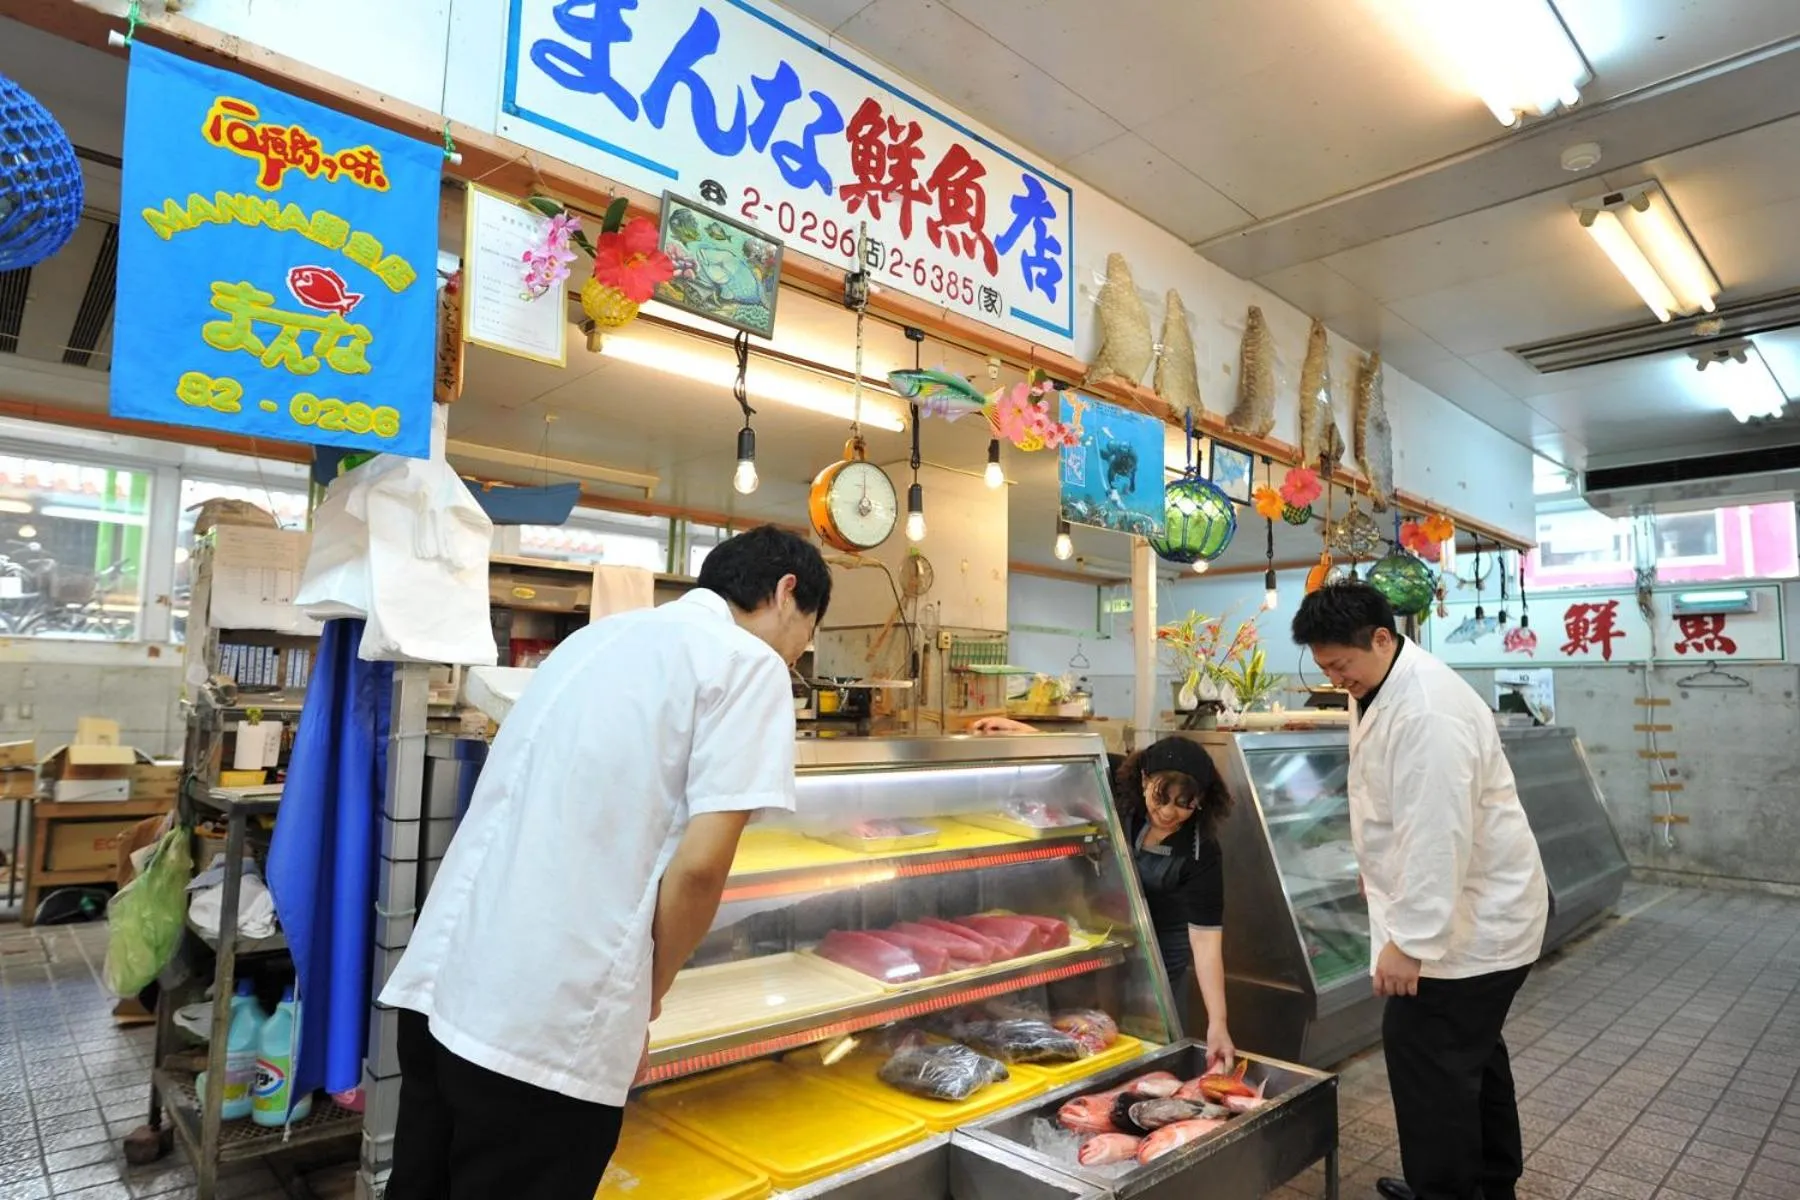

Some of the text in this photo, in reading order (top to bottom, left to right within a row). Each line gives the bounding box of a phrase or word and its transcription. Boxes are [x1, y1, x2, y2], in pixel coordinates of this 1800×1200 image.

[529, 0, 1064, 304] まんな鮮魚店
[202, 281, 374, 375] まんな
